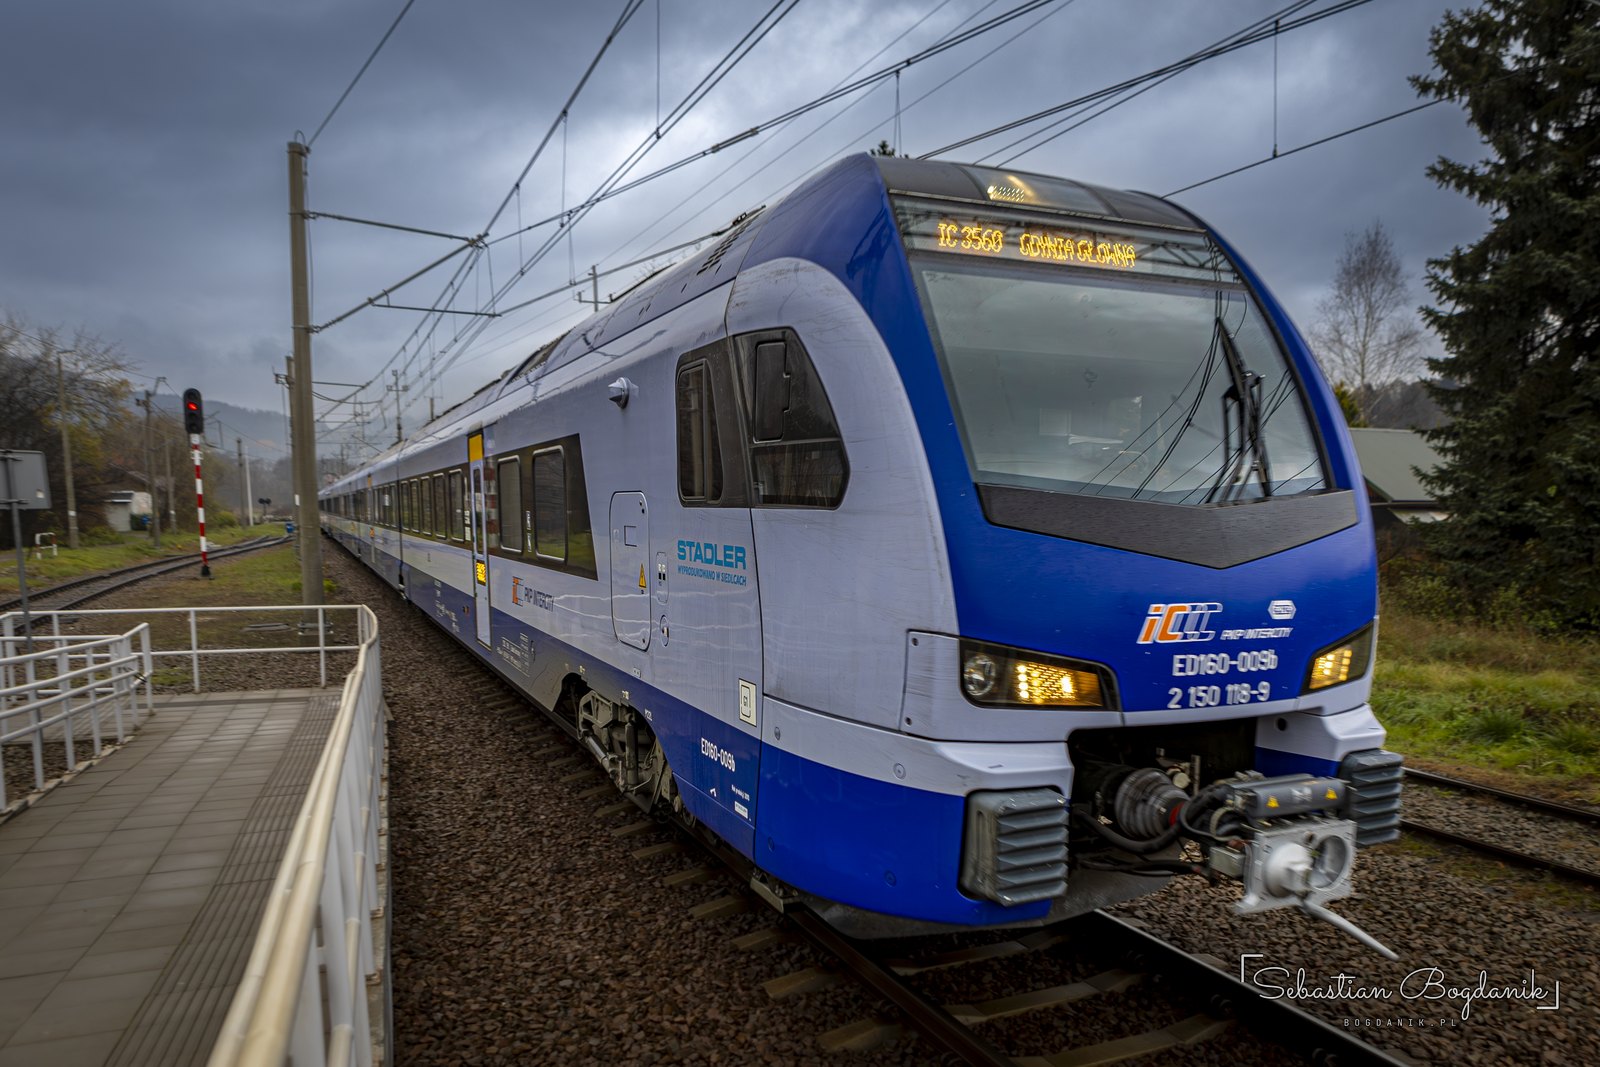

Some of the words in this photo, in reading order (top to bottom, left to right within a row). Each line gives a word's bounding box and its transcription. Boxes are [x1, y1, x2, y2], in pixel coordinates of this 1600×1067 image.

[938, 223, 958, 248] IC
[961, 226, 1003, 252] 3560
[1020, 233, 1075, 260] GDYNIA
[677, 540, 746, 570] STADLER
[677, 565, 716, 581] WYPRODUKOWANO
[720, 572, 747, 587] SIEDLCACH
[1172, 649, 1279, 677] ED160-009b
[1167, 687, 1183, 709] 2
[1188, 685, 1221, 708] 150
[1225, 681, 1271, 705] 118-9
